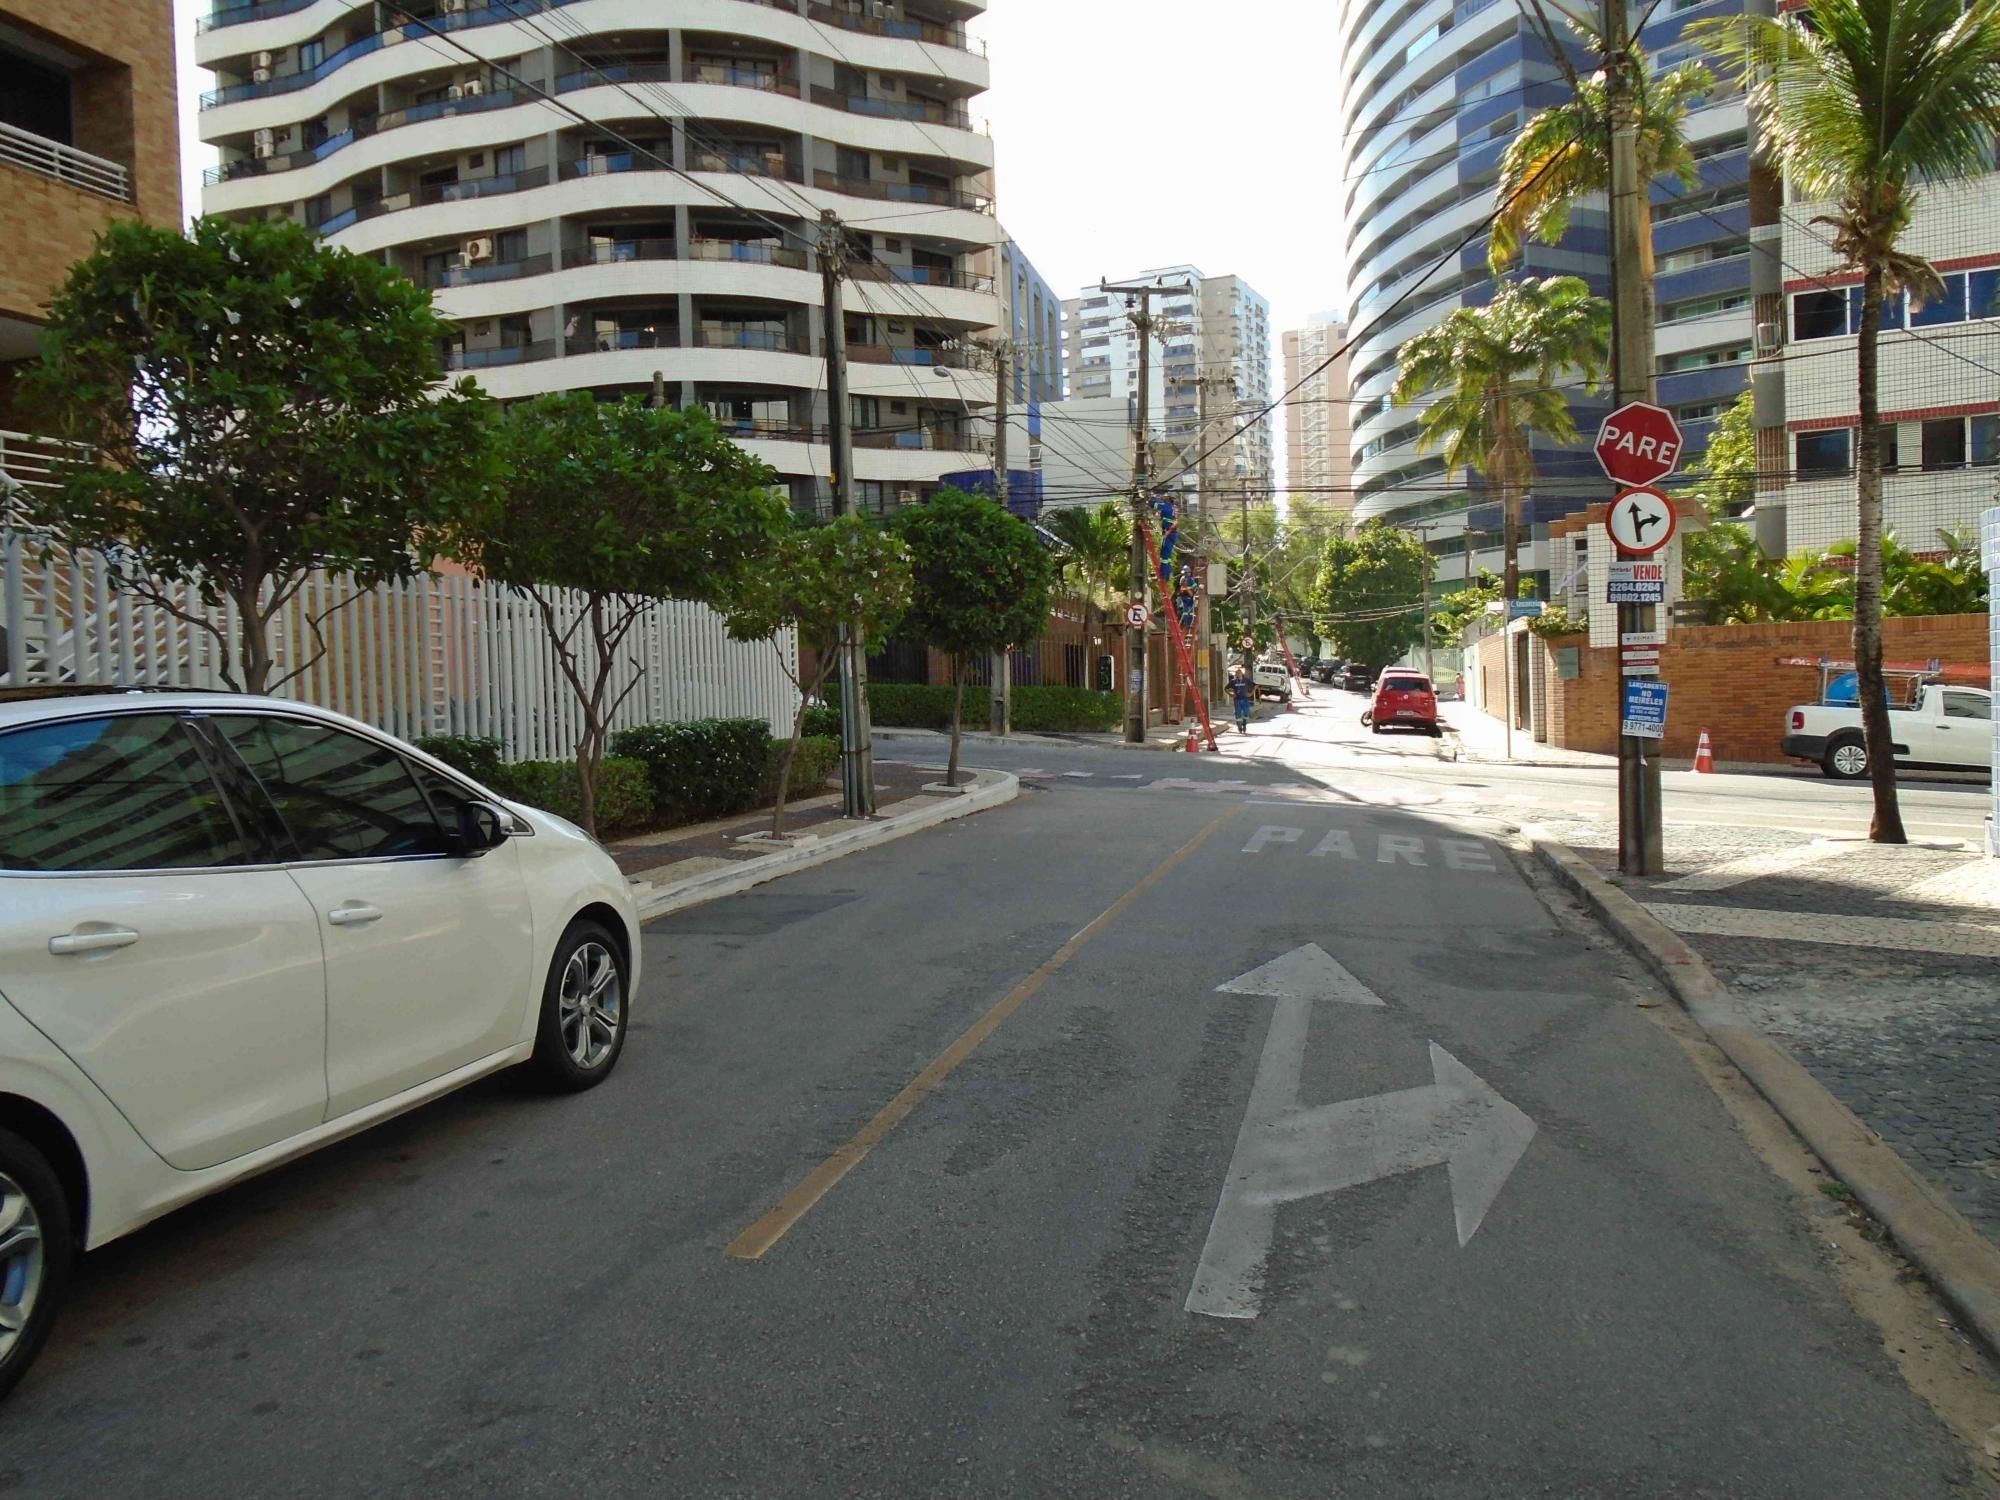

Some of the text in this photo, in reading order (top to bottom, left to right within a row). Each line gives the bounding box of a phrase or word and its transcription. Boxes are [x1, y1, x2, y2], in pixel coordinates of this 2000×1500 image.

[1600, 425, 1677, 465] PARE
[1633, 564, 1662, 580] VENDE
[1610, 583, 1660, 592] 3264.0264
[1628, 682, 1666, 690] LANÇAMENTO
[1628, 696, 1663, 705] MEIRELES
[1241, 825, 1497, 872] PARE
